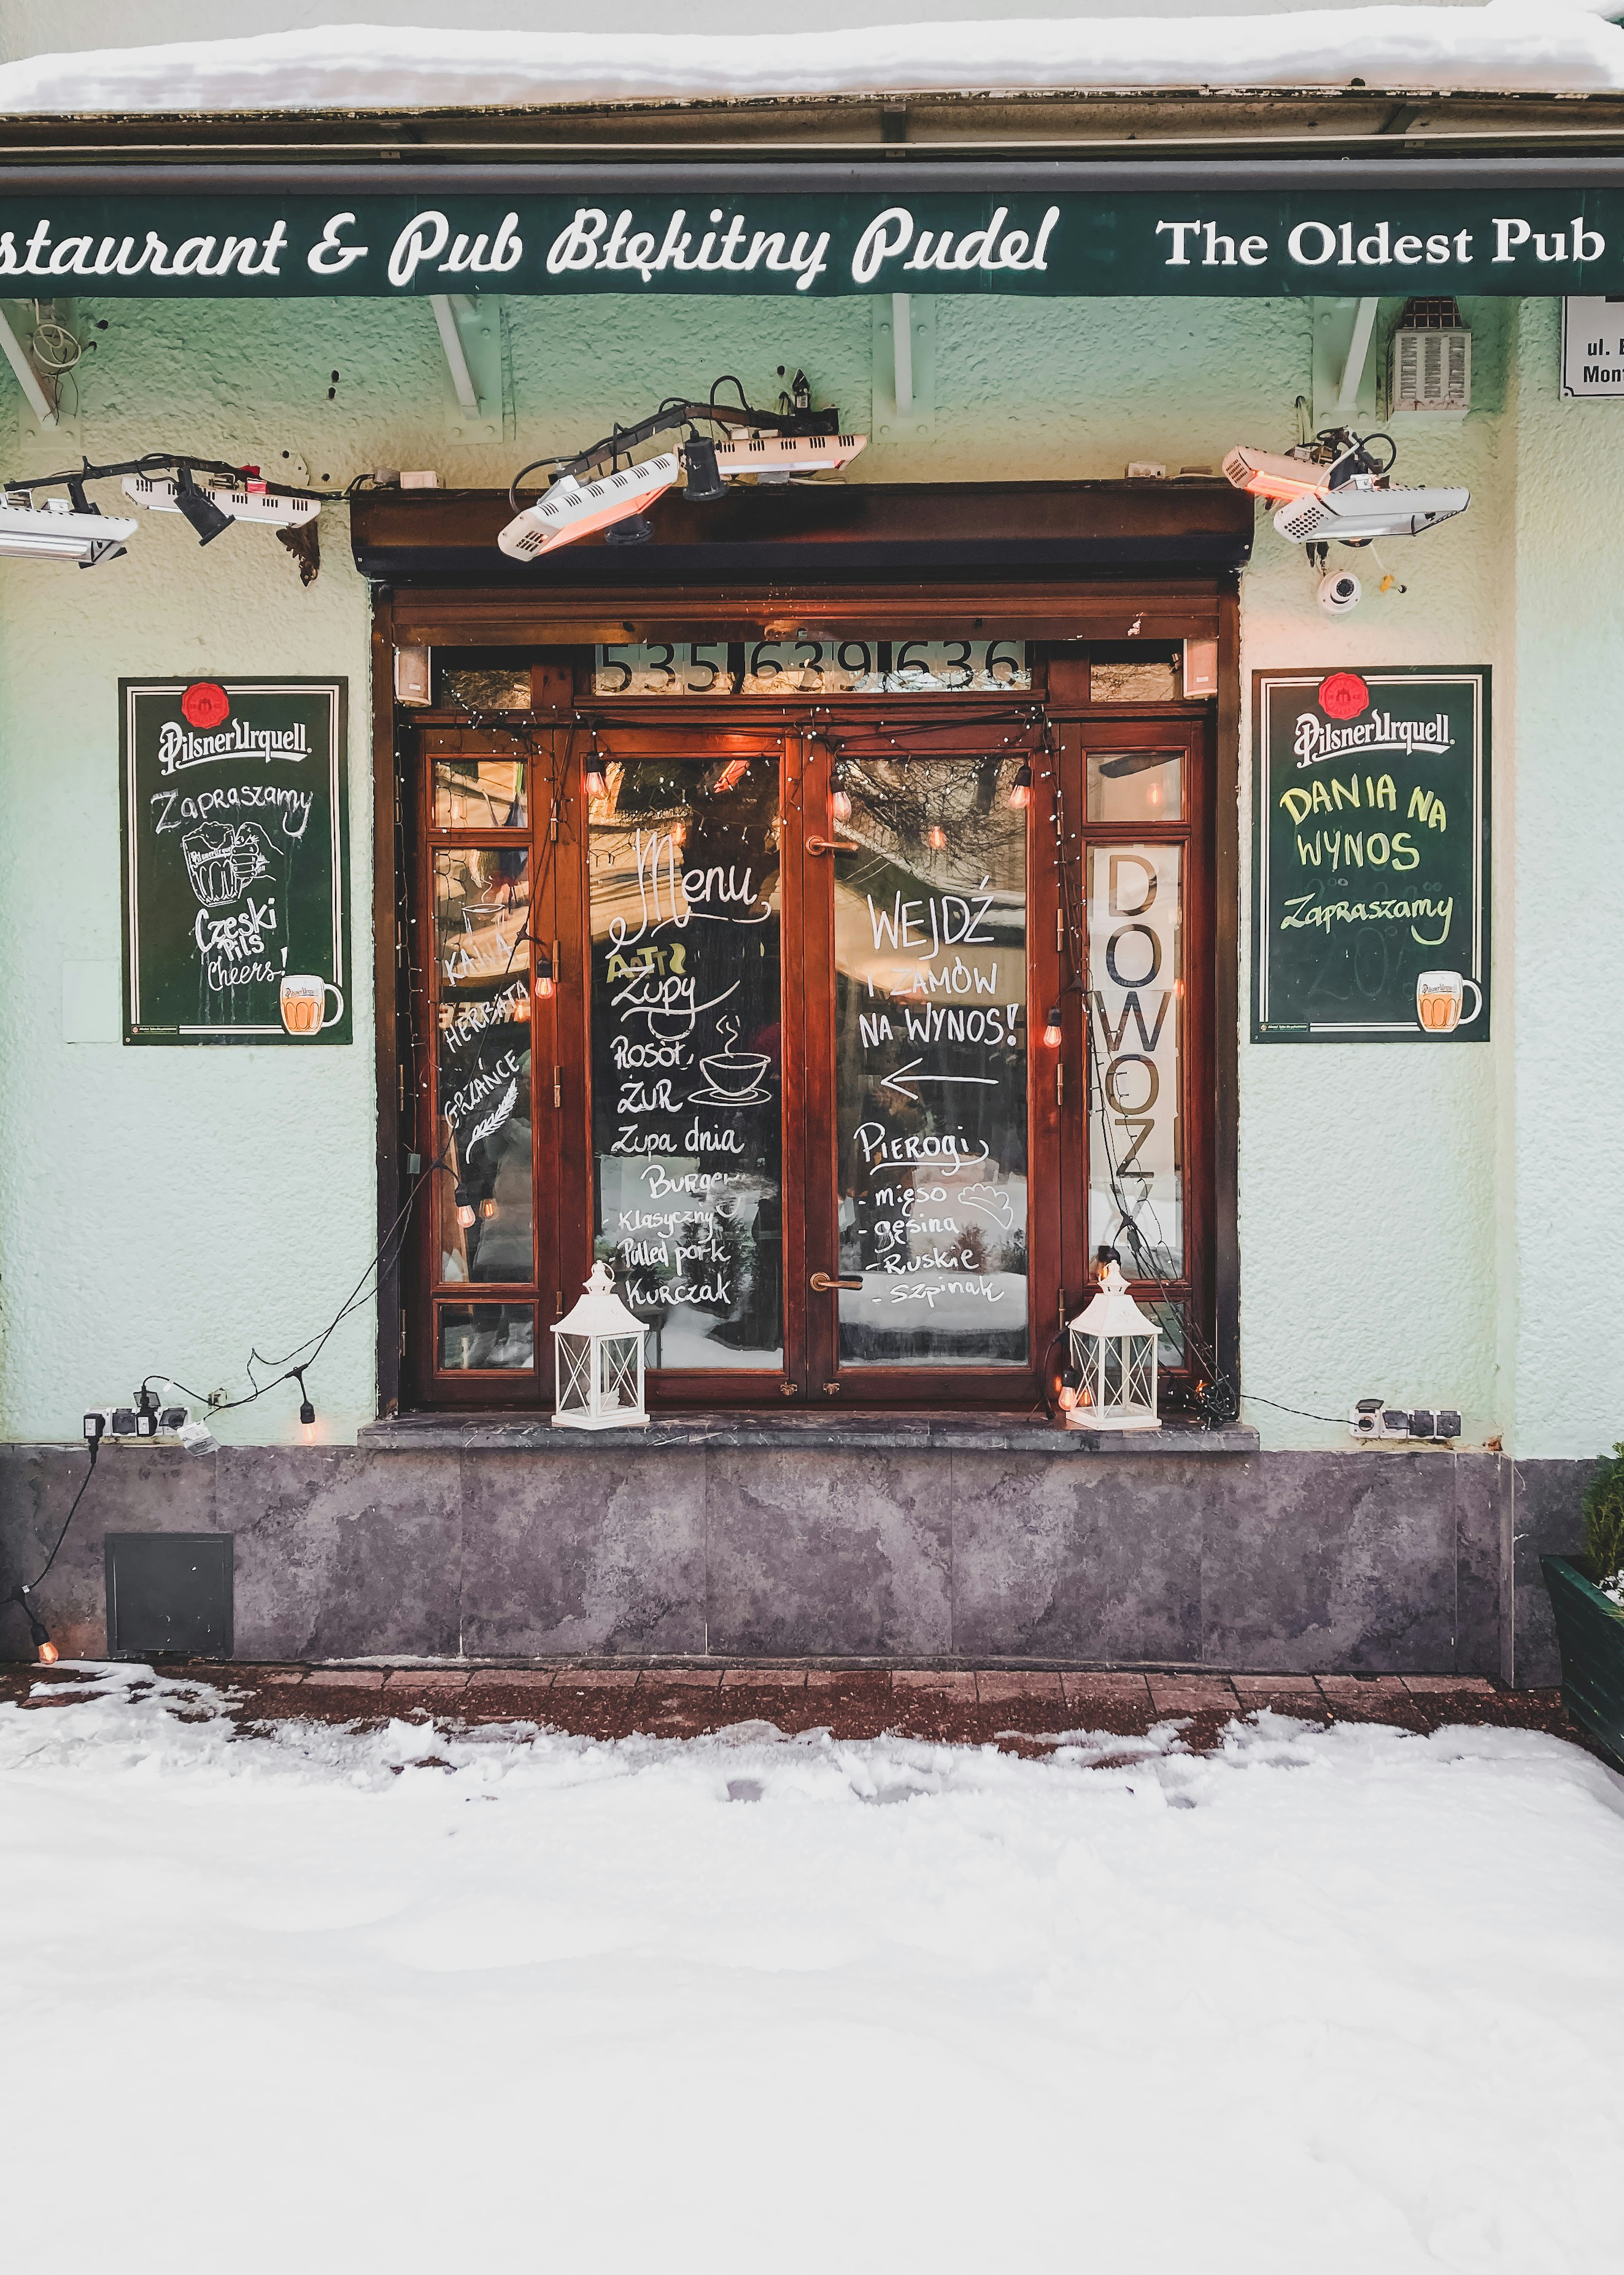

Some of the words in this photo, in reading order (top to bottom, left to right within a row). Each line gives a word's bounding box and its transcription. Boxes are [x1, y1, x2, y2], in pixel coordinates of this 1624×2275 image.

[307, 212, 368, 274] &
[387, 210, 523, 287] Pub
[546, 208, 830, 291] Błękitny
[853, 206, 1060, 284] Pudel
[1155, 219, 1269, 266] The
[1288, 220, 1474, 266] Oldest
[1491, 217, 1606, 264] Pub
[1587, 338, 1610, 356] ul.
[1583, 365, 1624, 383] Mon
[1279, 773, 1397, 826] DANIA
[1407, 786, 1447, 832] NA
[1297, 829, 1421, 872] WYNOS
[605, 828, 758, 959] Menu
[867, 874, 995, 960] WEJDŹ
[195, 897, 277, 953] Czeski
[890, 956, 998, 995] ZAMÓW
[611, 963, 697, 1041] Zupy
[859, 1012, 894, 1048] NA
[904, 1002, 1019, 1046] WYNOS!
[611, 1123, 678, 1162] Zupa
[684, 1115, 745, 1153] dnia
[617, 1238, 670, 1268] Pulled
[675, 1239, 732, 1277] pork
